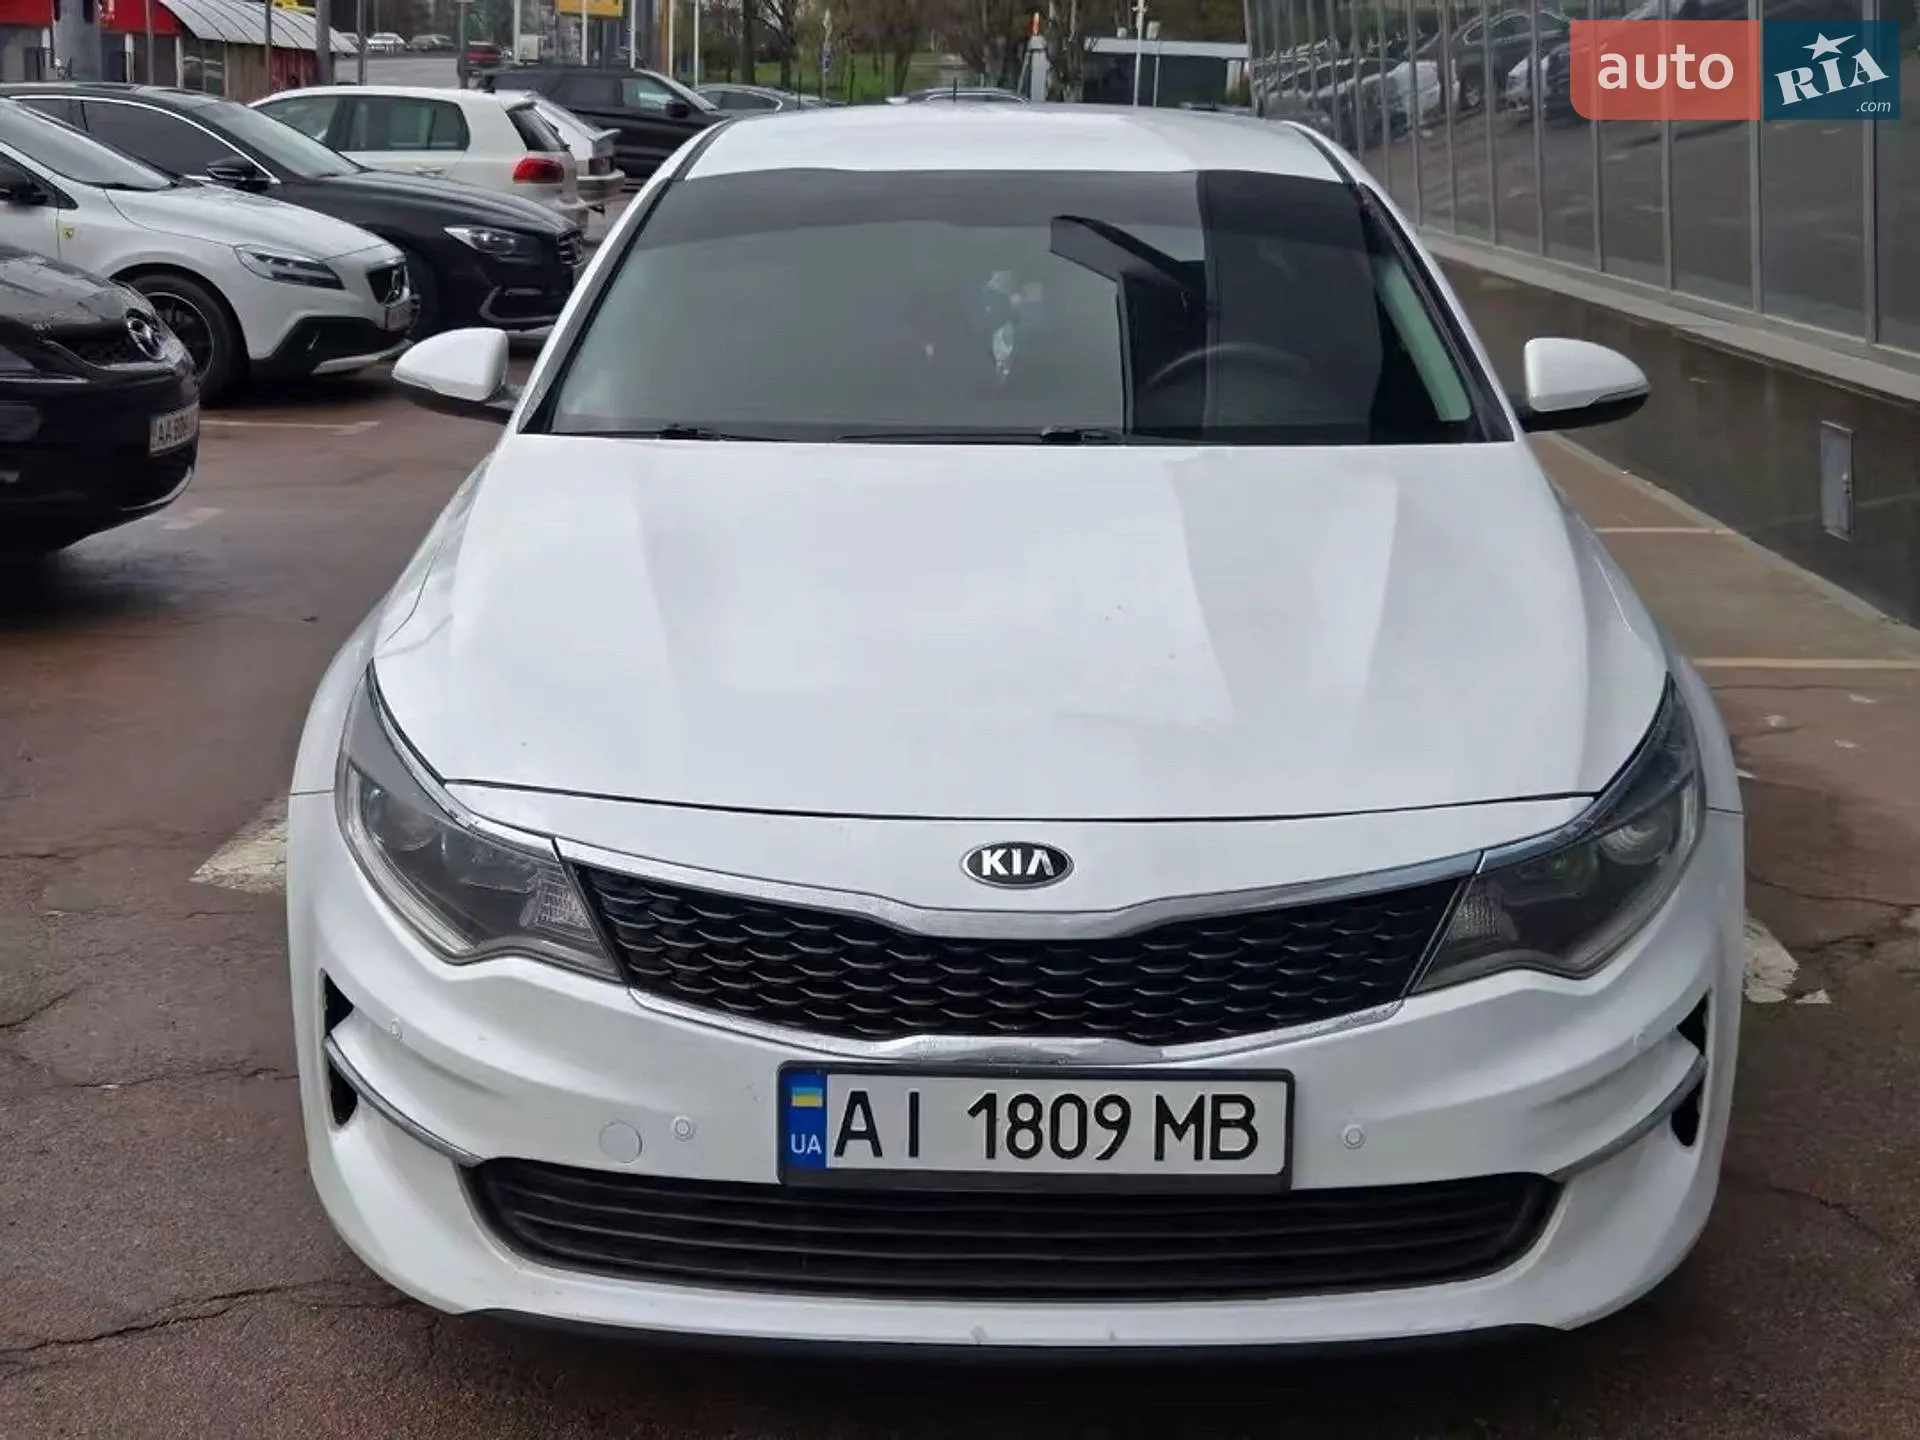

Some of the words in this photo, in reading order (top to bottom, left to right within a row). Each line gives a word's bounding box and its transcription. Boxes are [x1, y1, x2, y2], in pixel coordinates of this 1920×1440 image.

[981, 848, 1055, 876] KIA
[967, 1092, 1132, 1161] 1809
[1154, 1093, 1259, 1162] MB
[790, 1134, 822, 1155] UA
